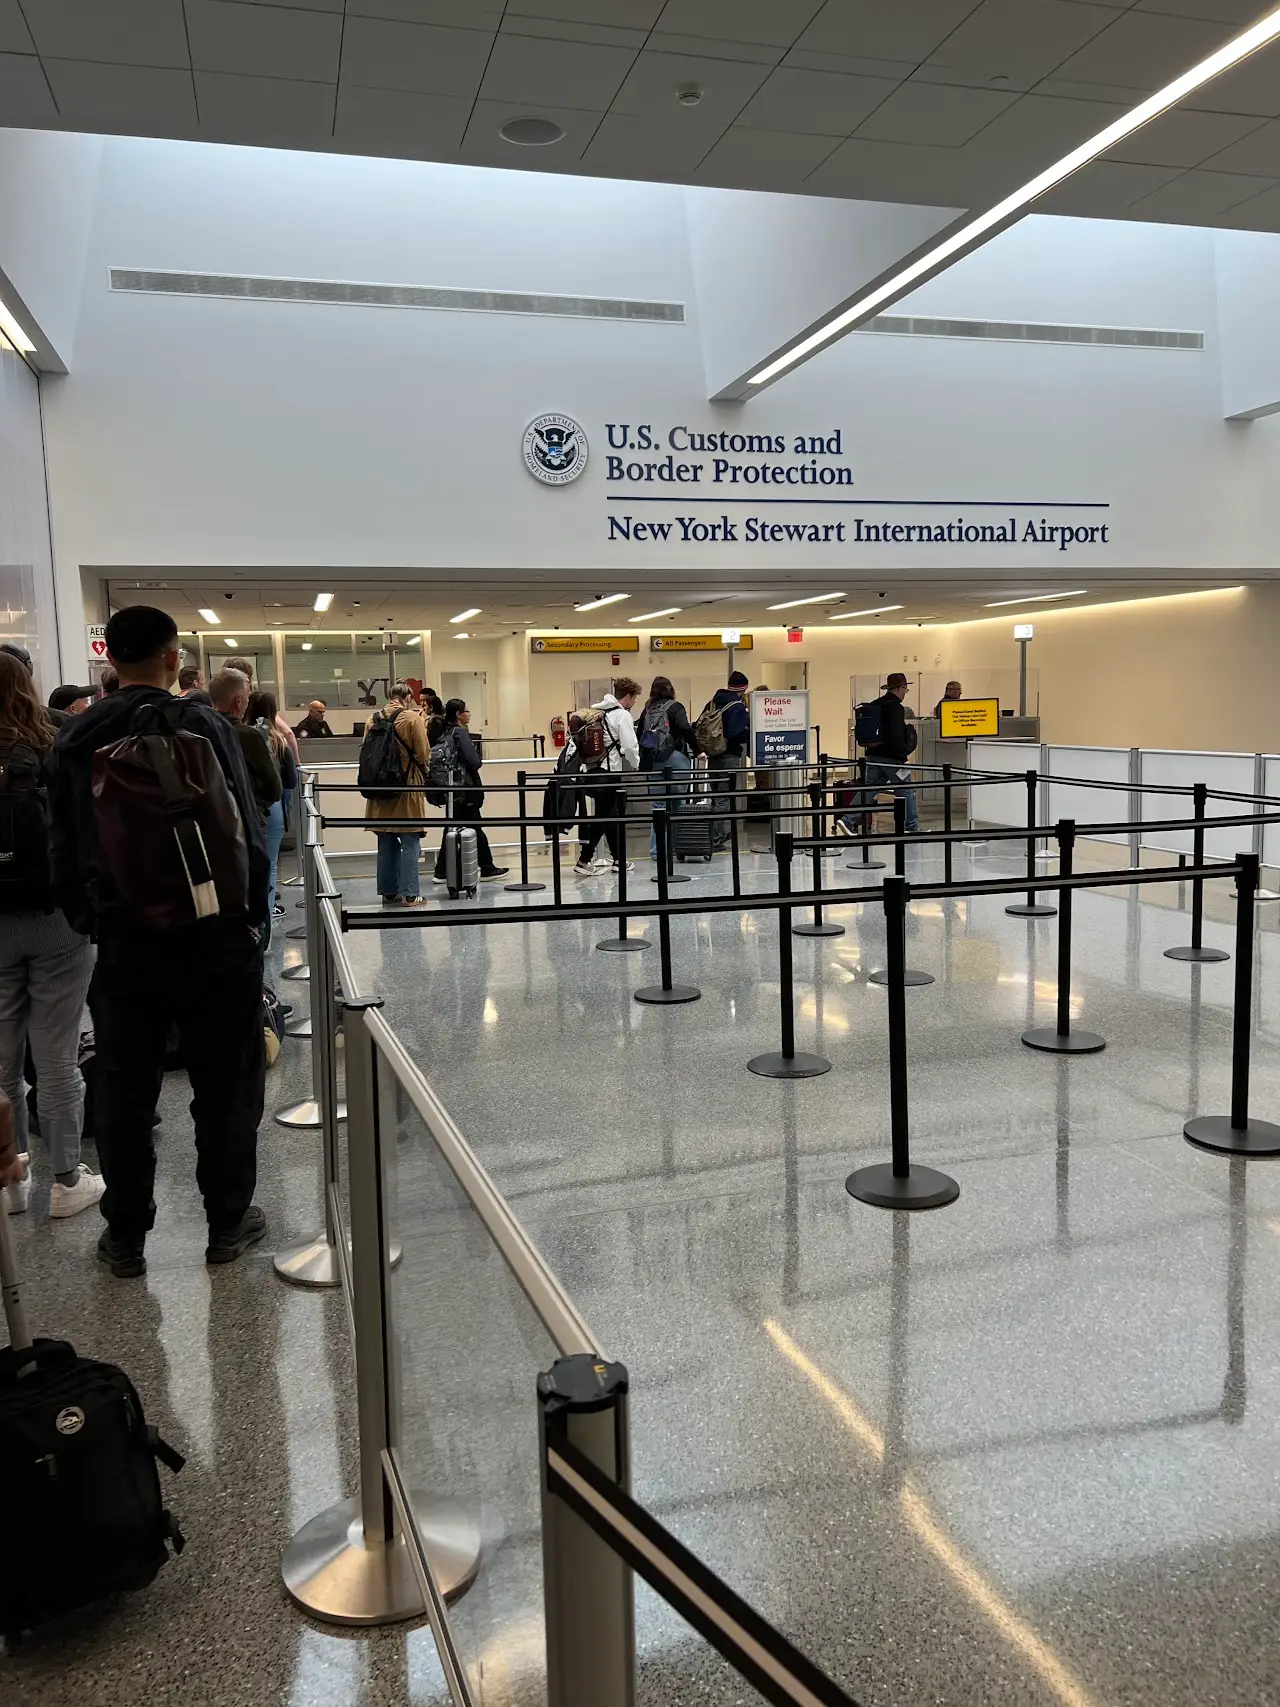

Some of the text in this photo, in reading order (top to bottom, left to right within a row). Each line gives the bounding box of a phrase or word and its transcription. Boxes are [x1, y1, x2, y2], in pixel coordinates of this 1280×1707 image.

[534, 416, 582, 435] DEPARTMENT
[605, 424, 843, 455] U.S. Customs and
[525, 452, 586, 482] HOMELAND SECURITY
[606, 456, 854, 485] Border Protection
[607, 516, 1109, 550] New York Stewart International Airport
[90, 627, 106, 636] AED
[546, 641, 612, 649] Secondary Processing
[674, 640, 707, 649] Passengers
[764, 697, 792, 706] Please
[764, 707, 783, 716] Wait
[764, 734, 785, 743] Favor
[764, 743, 805, 752] de esperar
